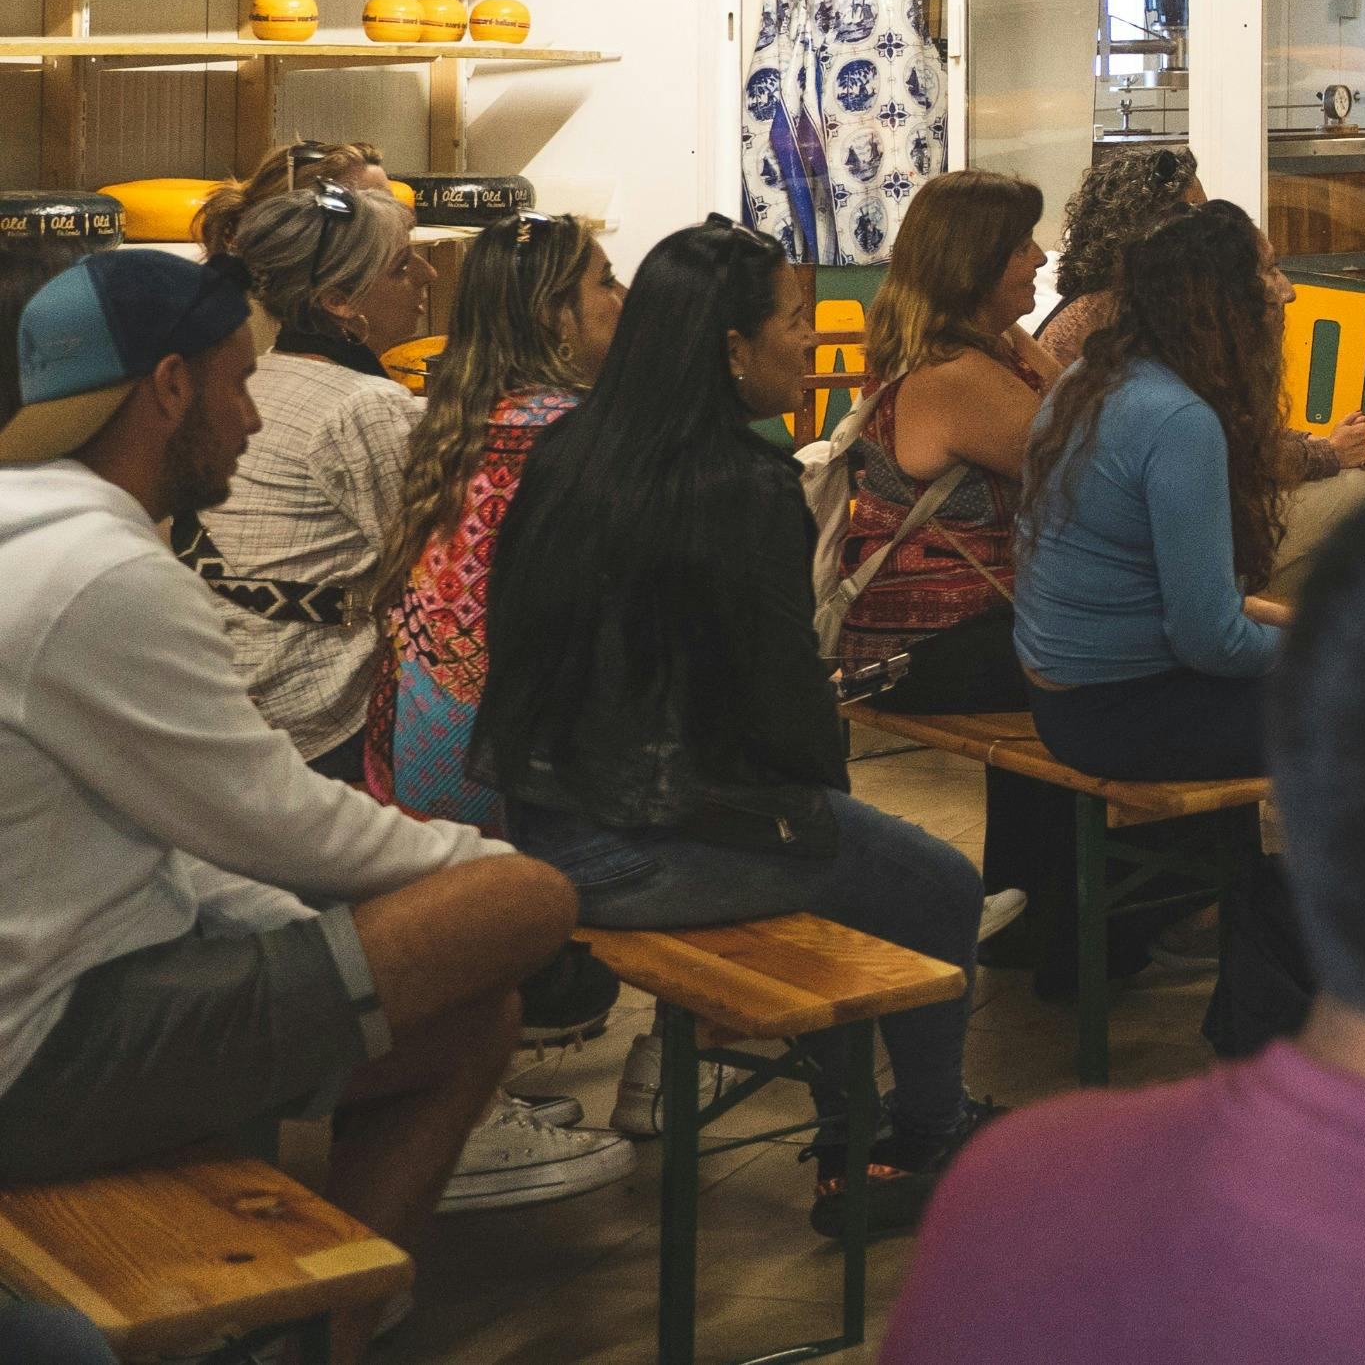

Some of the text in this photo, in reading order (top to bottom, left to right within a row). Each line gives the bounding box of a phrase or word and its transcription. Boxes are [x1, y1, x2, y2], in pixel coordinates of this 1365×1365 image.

[442, 189, 465, 202] Old
[482, 189, 502, 202] Old
[0, 216, 27, 230] Old
[51, 215, 76, 230] Old
[93, 214, 110, 228] Old
